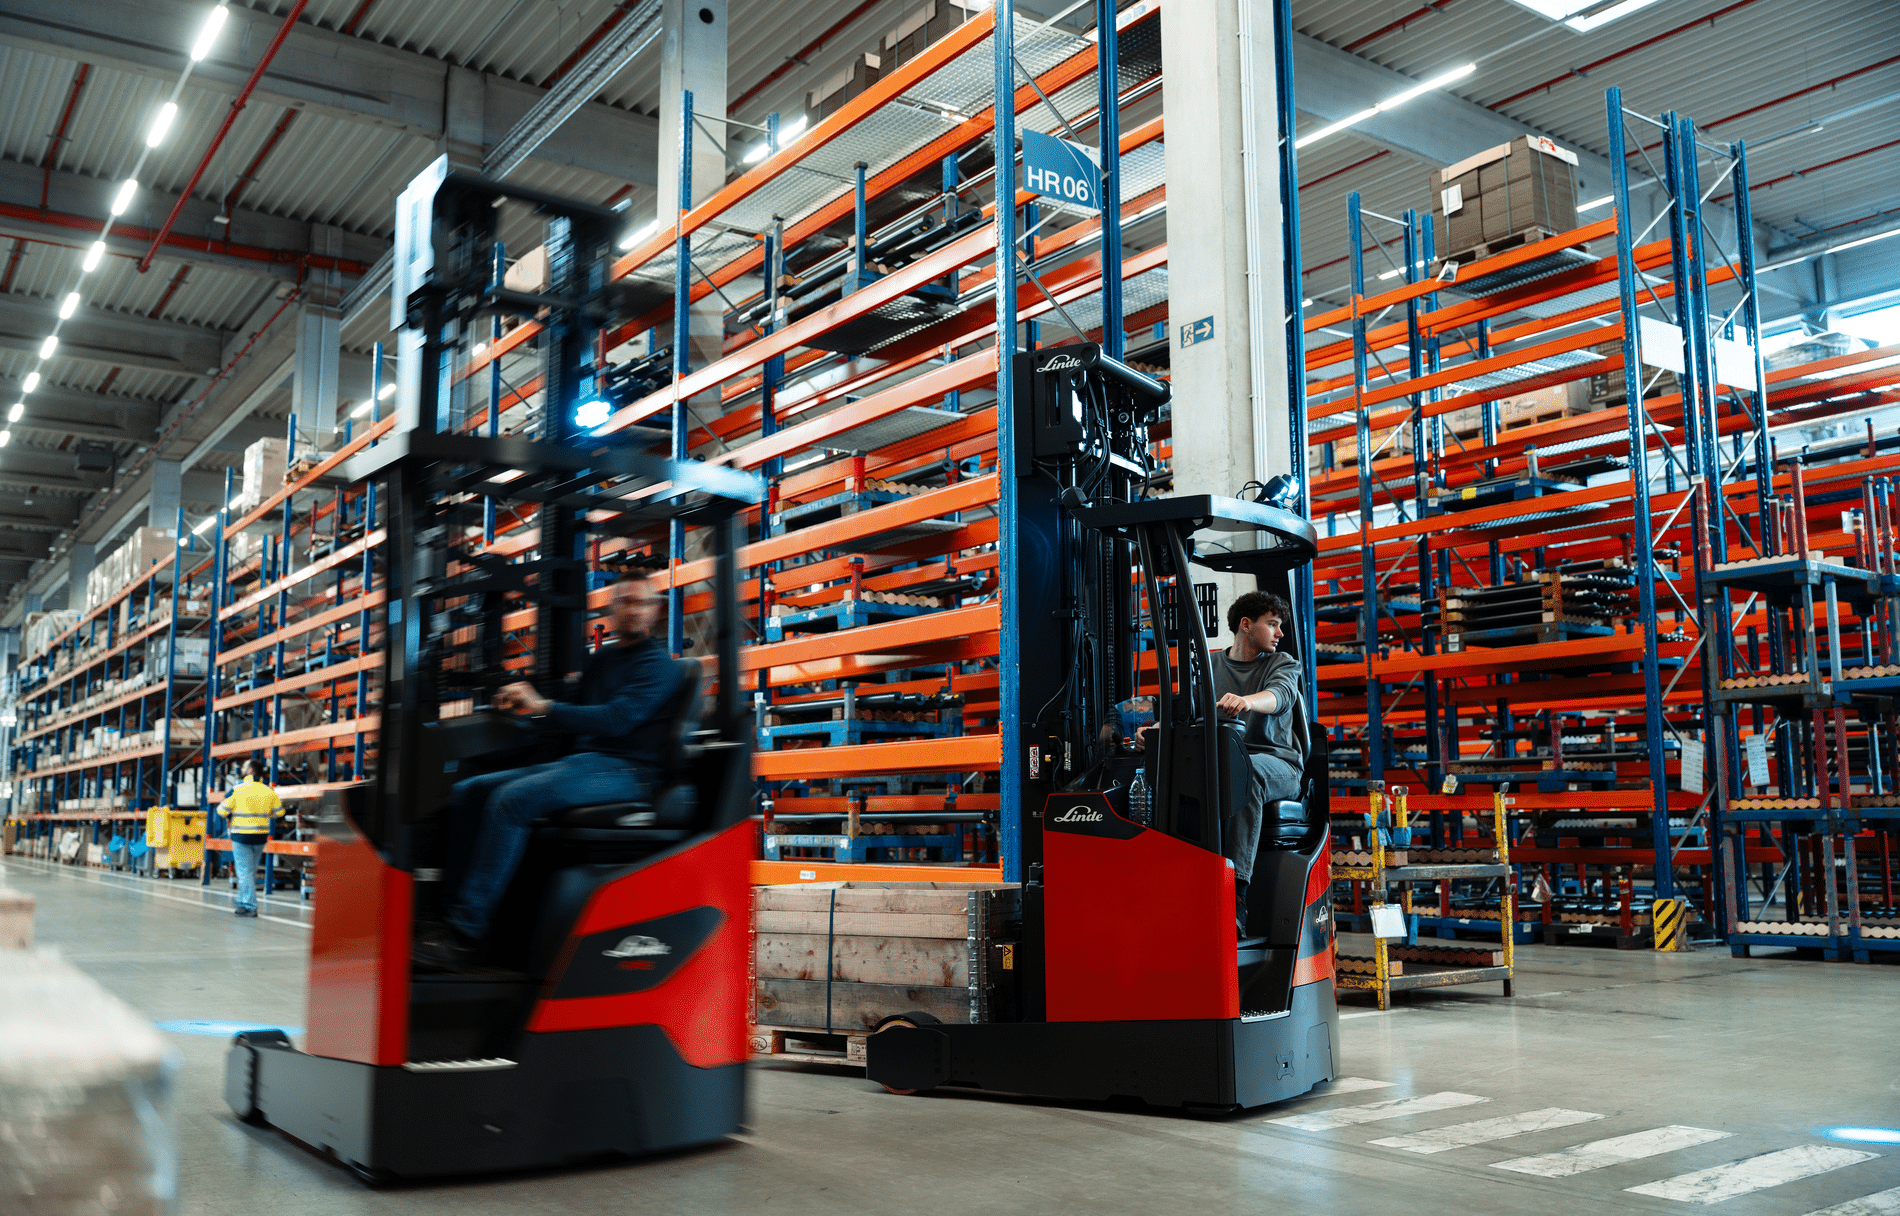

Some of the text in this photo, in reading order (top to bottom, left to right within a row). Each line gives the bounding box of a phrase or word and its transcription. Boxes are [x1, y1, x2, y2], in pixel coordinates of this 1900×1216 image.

[1028, 165, 1089, 202] HR 06
[1036, 353, 1081, 372] Linde
[1053, 805, 1104, 822] Linde
